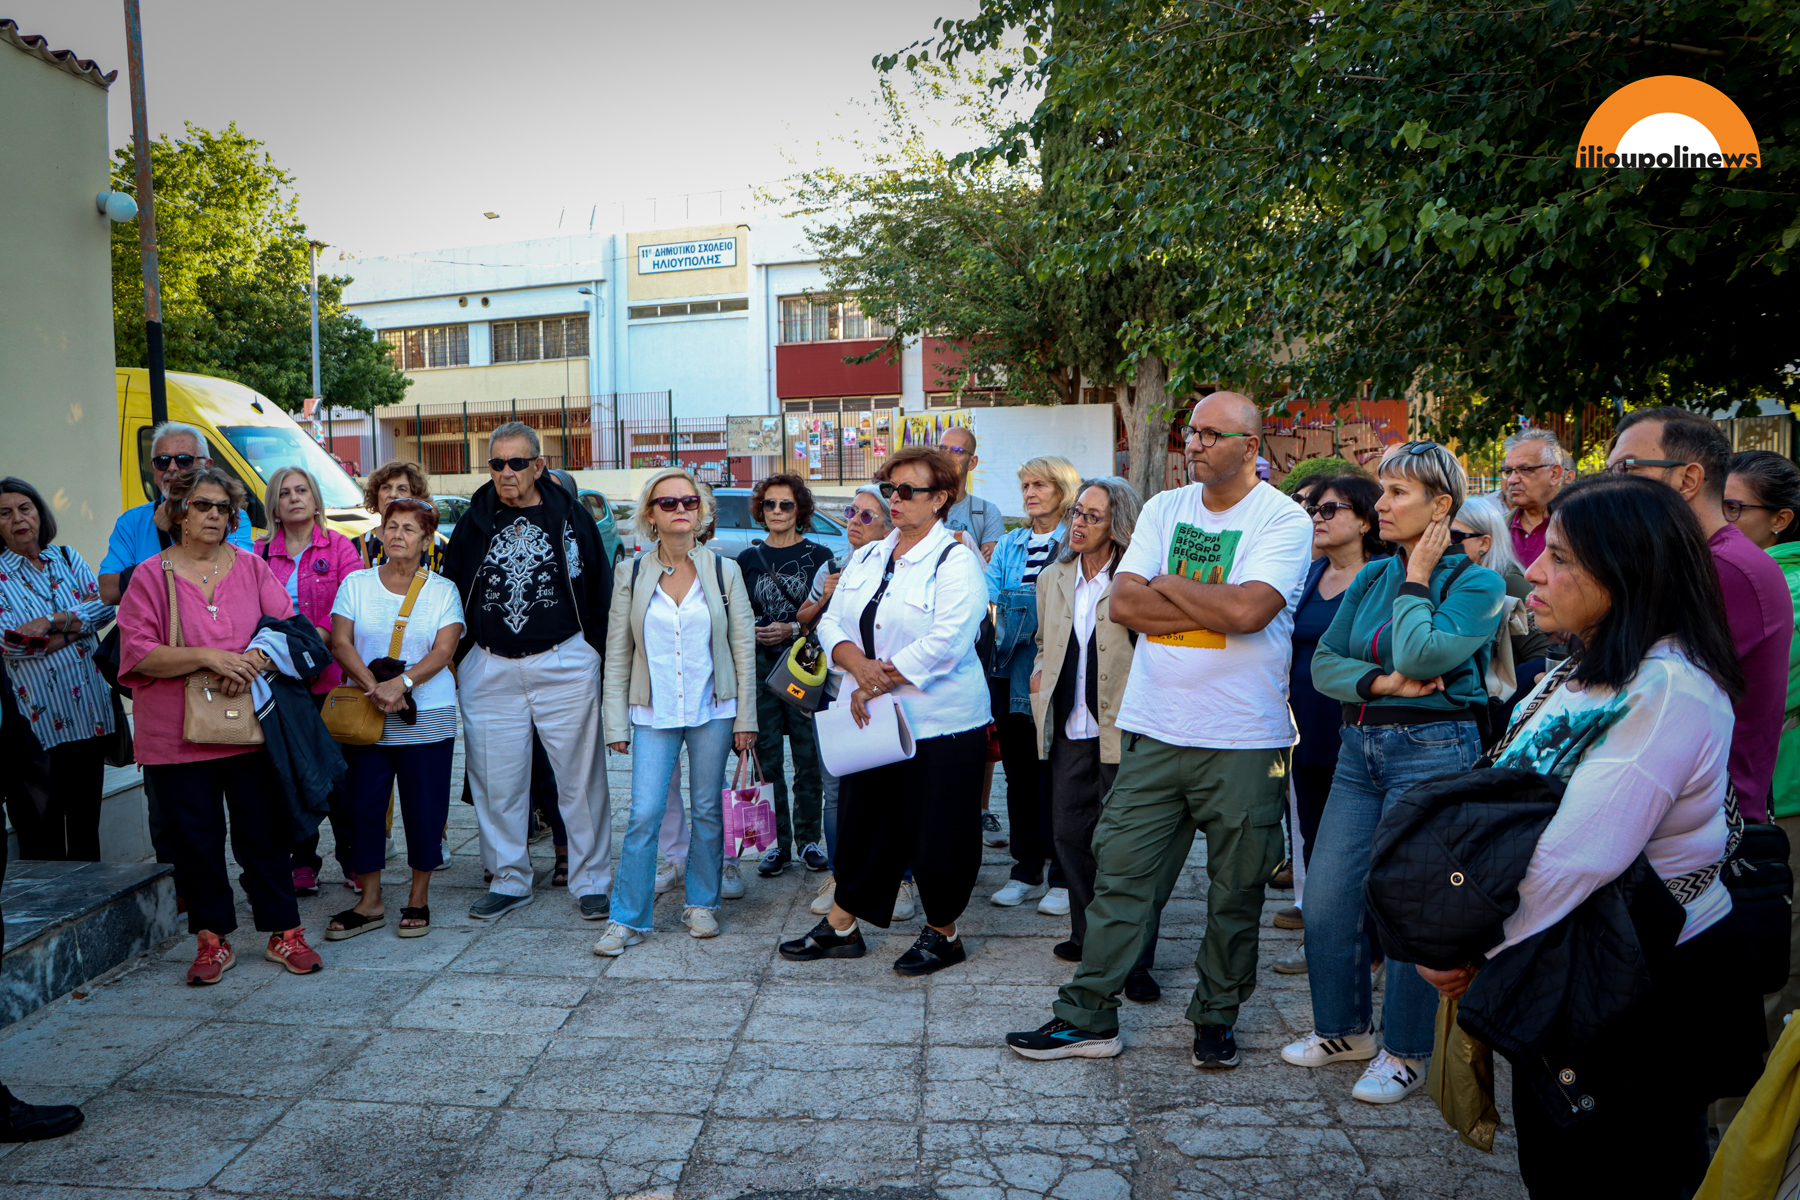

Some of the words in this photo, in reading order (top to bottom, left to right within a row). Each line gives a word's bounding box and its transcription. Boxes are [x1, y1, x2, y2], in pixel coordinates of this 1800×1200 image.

[655, 244, 696, 257] ΔΗΜΟΤΙΚΟ
[698, 241, 733, 253] ΣΧΟΛΕΙΟ
[653, 254, 722, 270] ΗΛΙΟΥΠΟΛΗΣ
